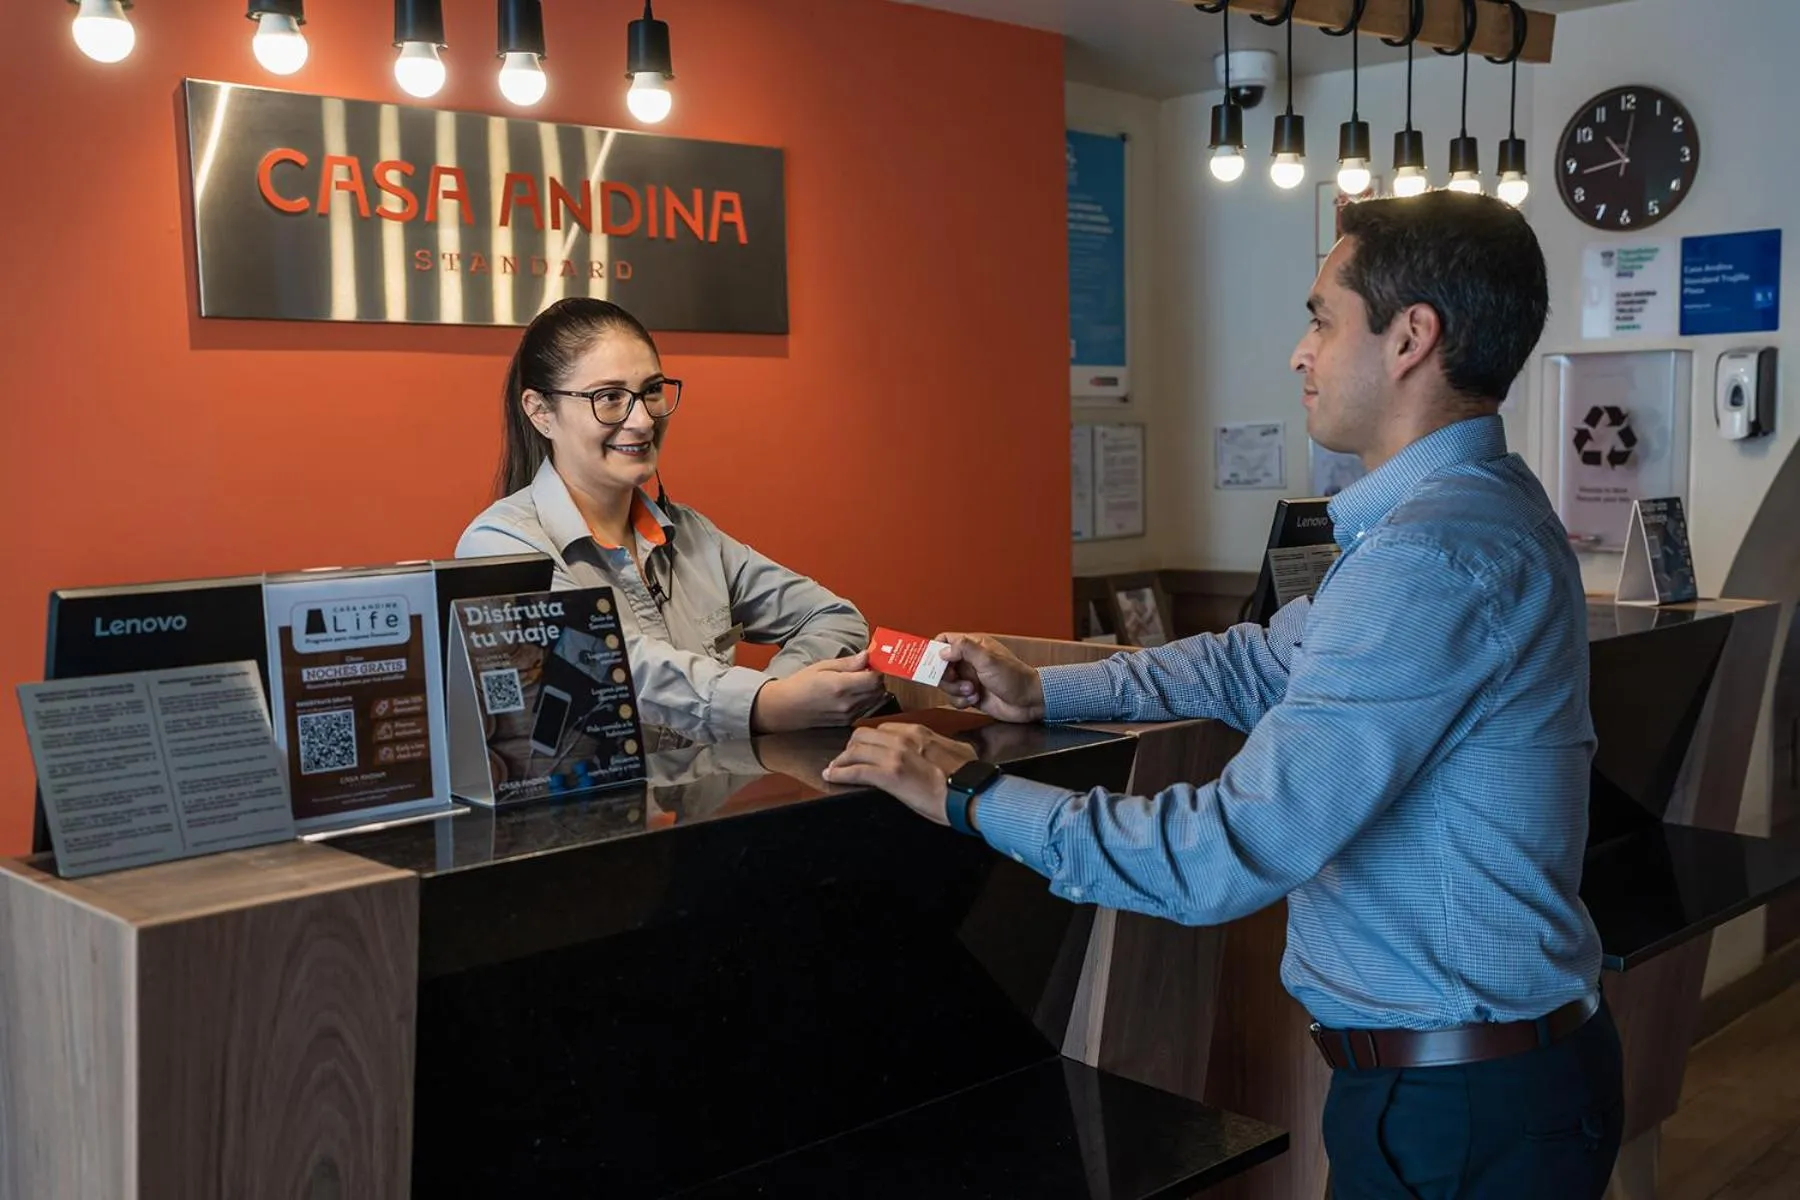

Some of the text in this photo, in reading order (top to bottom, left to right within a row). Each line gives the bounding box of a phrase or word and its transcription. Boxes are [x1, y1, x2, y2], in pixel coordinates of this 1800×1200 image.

[1621, 94, 1636, 111] 12
[1656, 100, 1662, 116] 1
[1596, 106, 1606, 123] 11
[1672, 116, 1683, 132] 2
[1577, 126, 1593, 144] 10
[1680, 146, 1690, 162] 3
[1566, 158, 1577, 174] 9
[257, 147, 748, 245] CASA ANDINA
[1574, 187, 1585, 203] 8
[1595, 203, 1606, 220] 7
[1648, 200, 1659, 216] 5
[1620, 209, 1631, 225] 6
[414, 250, 634, 281] STANDARD
[1684, 262, 1734, 273] Casa Andina
[1296, 515, 1328, 528] Lenovo
[333, 611, 399, 633] Life
[464, 601, 565, 626] Disfruta
[95, 614, 188, 637] Lenovo
[470, 624, 560, 648] tu viaje
[306, 660, 404, 680] NOCHES GRATIS
